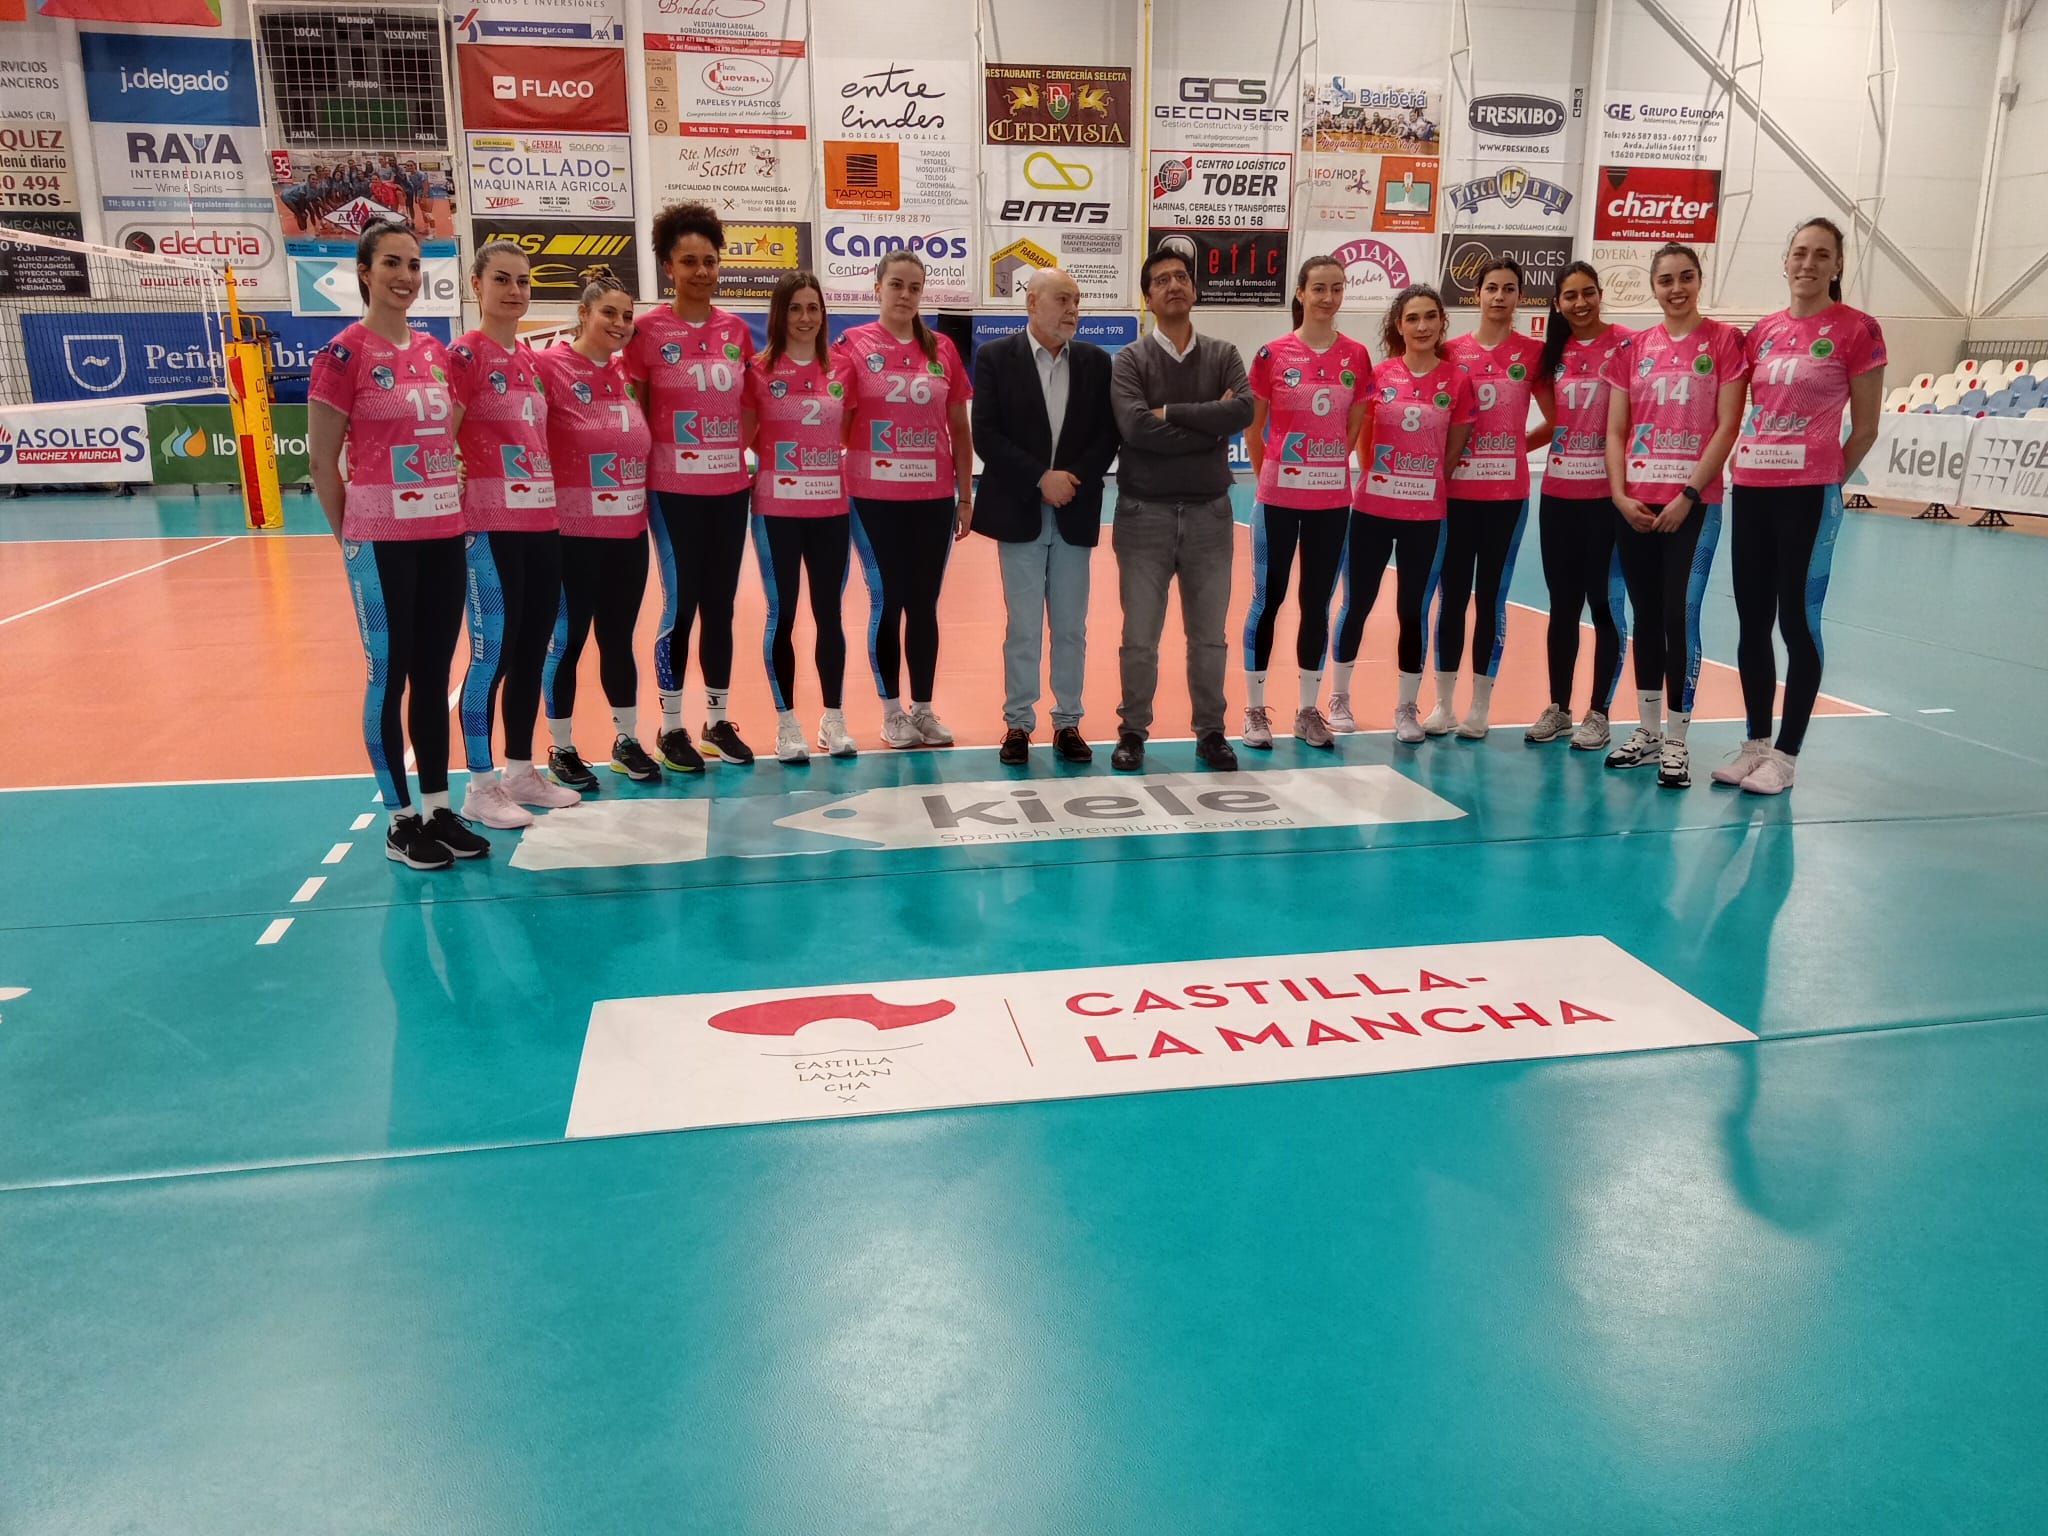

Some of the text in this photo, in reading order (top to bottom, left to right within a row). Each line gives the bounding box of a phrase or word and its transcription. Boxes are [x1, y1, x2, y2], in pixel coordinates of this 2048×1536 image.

[294, 27, 428, 42] LOCAL VISITANTE
[497, 25, 575, 36] www.atosegur.com
[120, 64, 228, 95] j.delgado
[348, 80, 379, 90] PERIODO
[841, 62, 946, 99] entre
[985, 67, 1127, 86] RESTAURANTE CERVECERÍA SELECTA
[521, 79, 594, 99] FLACO
[1178, 77, 1268, 105] GCS
[696, 98, 731, 107] PAPELES
[732, 99, 738, 107] Y
[1361, 88, 1428, 109] Barberá
[841, 101, 946, 129] lindes
[1154, 105, 1289, 123] GECONSER
[1476, 106, 1557, 125] FRESKIBO
[1607, 104, 1633, 121] GE
[291, 130, 316, 139] FALTAS
[841, 132, 891, 140] BODEGAS
[1622, 132, 1638, 140] 926
[126, 132, 242, 165] RAYA
[531, 139, 563, 150] GENERAL
[678, 144, 740, 161] Rte. Mesón
[1478, 144, 1550, 155] WWW.FRESKIBO.ES
[30, 155, 67, 169] diario
[919, 150, 951, 158] TAPIZADOS
[923, 158, 947, 166] ESTORES
[1635, 152, 1661, 160] PEDRO
[1662, 150, 1693, 162] MUÑOZ
[488, 156, 612, 178] COLLADO
[687, 161, 747, 178] del Sastre
[915, 166, 956, 174] MOSQUITERAS
[1196, 155, 1286, 172] CENTRO LOGÍSTICO
[22, 175, 61, 191] 494
[130, 170, 244, 182] INTERMEDIARIOS
[924, 174, 947, 182] TOLDOS
[155, 182, 182, 194] Wine
[472, 177, 628, 194] MAQUINARIA AGRICOLA
[723, 184, 750, 193] COMIDA
[751, 185, 788, 193] MANCHEGA
[834, 189, 893, 200] TAPYCOR
[919, 190, 952, 198] CABECEROS
[1201, 173, 1279, 198] TOBER
[1532, 181, 1567, 208] BAR
[1152, 201, 1187, 213] HARINAS,
[1188, 202, 1226, 213] CEREALES
[1234, 203, 1287, 214] TRANSPORTES
[1607, 191, 1714, 219] charter
[878, 214, 932, 225] 617 98 28 70
[1173, 213, 1264, 226] Tel. 926 53 01 58
[159, 230, 260, 256] electria
[825, 226, 968, 259] Campos
[1611, 228, 1695, 240] en Villarta de San Juan
[1063, 240, 1121, 248] MANTENIMIENTO
[1502, 249, 1566, 267] DULCES
[1592, 246, 1639, 261] JOYERÍA
[828, 262, 965, 278] Centro Dental
[1208, 278, 1277, 288] empleo formación
[1079, 324, 1125, 336] desde 1978
[685, 363, 734, 392] 10
[1766, 357, 1800, 386] 11
[884, 375, 933, 405] 26
[1477, 383, 1497, 411] 9
[1562, 382, 1599, 411] 17
[1651, 376, 1690, 406] 14
[405, 387, 449, 422] 15
[1311, 387, 1331, 417] 6
[521, 396, 535, 427] 4
[608, 405, 629, 433] 7
[801, 399, 821, 426] 2
[1400, 406, 1422, 432] 8
[1761, 411, 1807, 431] kiele
[895, 424, 937, 448] kiele
[1475, 431, 1515, 450] kiele
[1566, 431, 1607, 450] kiele
[1653, 430, 1701, 450] kiele
[19, 453, 68, 462] SANCHEZ
[79, 452, 120, 462] MURCIA
[1306, 437, 1344, 459] kiele
[801, 448, 840, 473] kiele
[1394, 452, 1434, 472] kiele
[1888, 437, 1965, 481] kiele
[921, 784, 1281, 830] kiele
[939, 815, 1296, 845] Spanish Premium Seafood
[1064, 968, 1489, 1017] CASTILLA-
[1083, 999, 1617, 1063] LA MANCHA
[794, 1056, 894, 1071] CASTILLA
[799, 1067, 892, 1083] LAMAN
[823, 1081, 872, 1093] CHA
